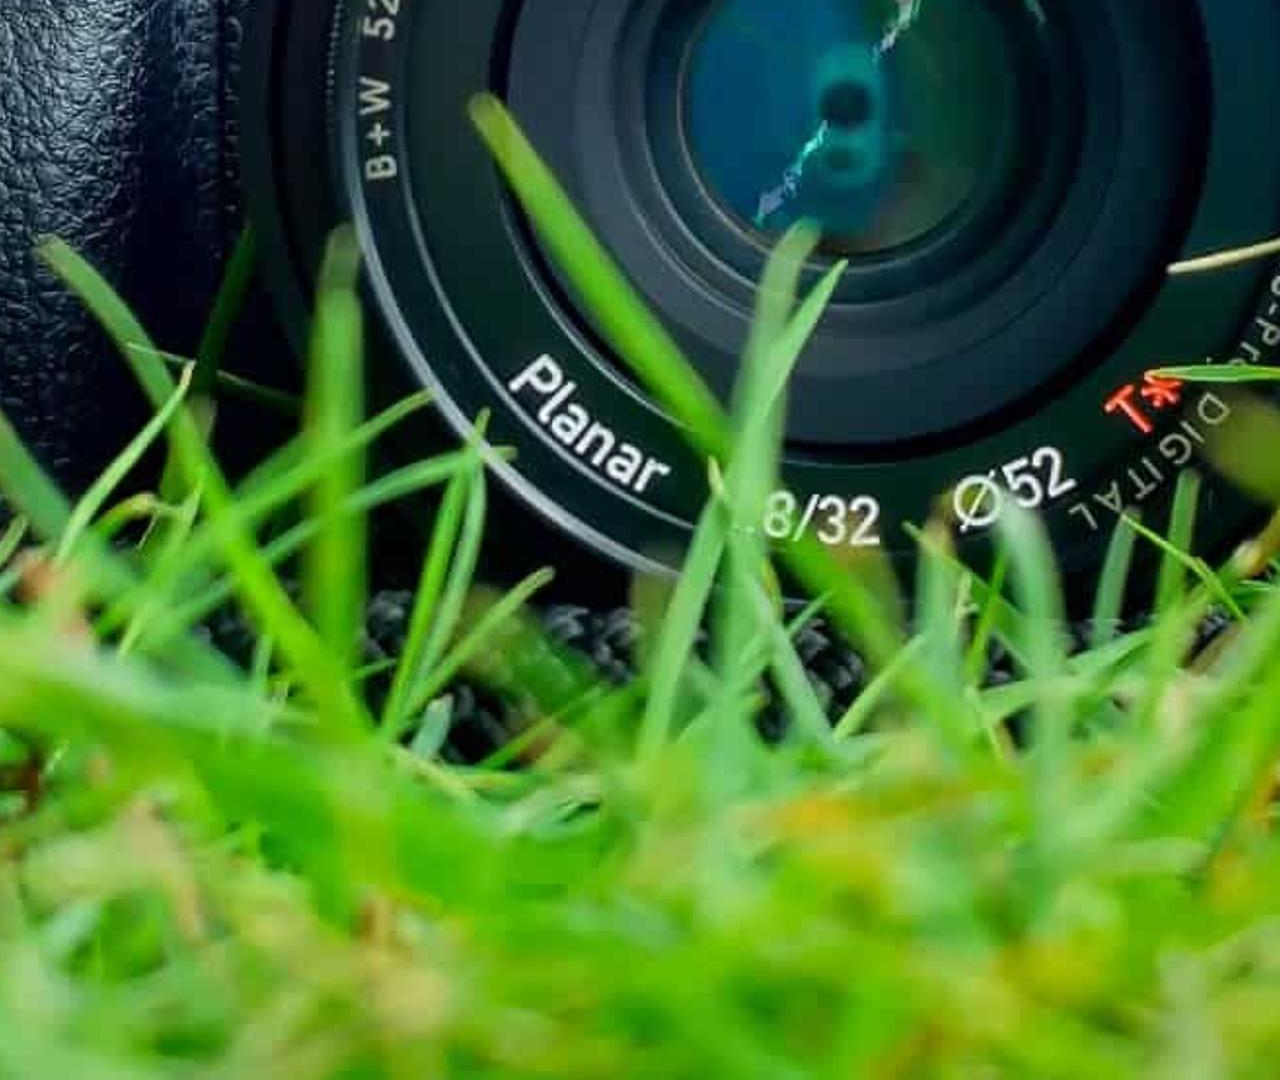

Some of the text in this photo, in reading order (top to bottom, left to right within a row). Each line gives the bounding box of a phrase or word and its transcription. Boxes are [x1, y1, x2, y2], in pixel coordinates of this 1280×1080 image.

[358, 76, 398, 181] B+W
[507, 353, 672, 492] Planar
[1069, 391, 1230, 530] DIGITAL
